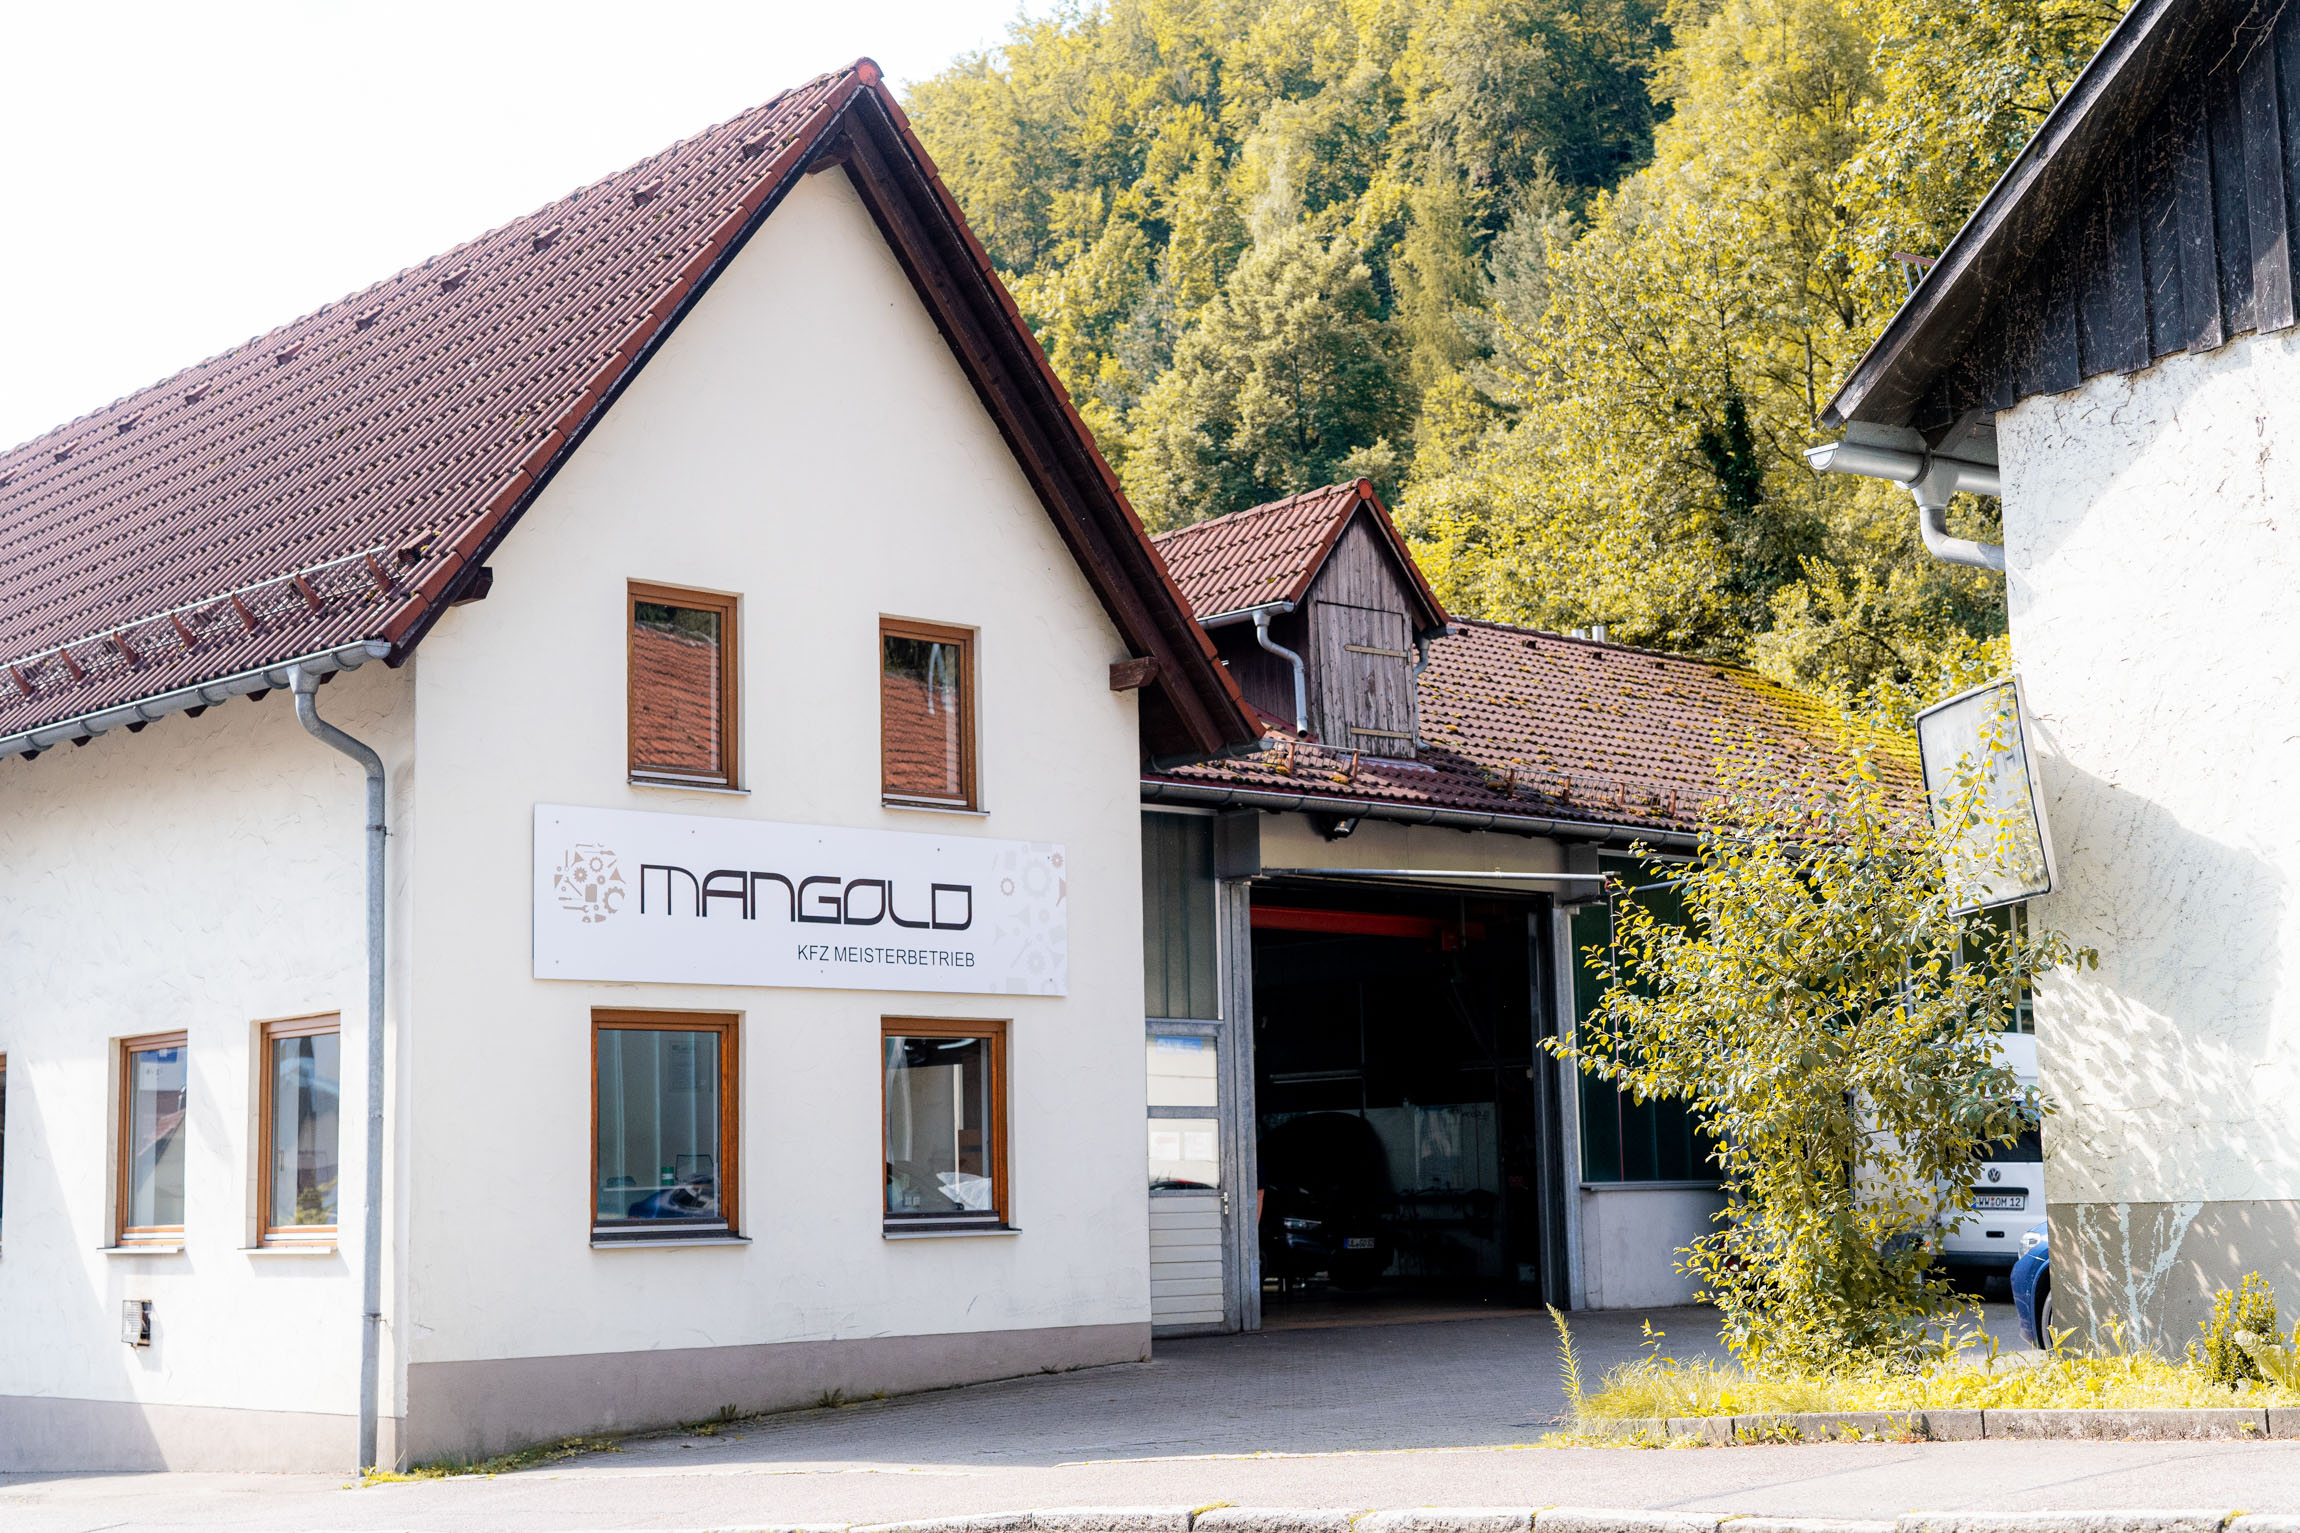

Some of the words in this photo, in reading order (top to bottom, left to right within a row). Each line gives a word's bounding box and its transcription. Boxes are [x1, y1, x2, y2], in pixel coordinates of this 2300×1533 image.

[641, 864, 972, 931] MANGOLD
[797, 944, 830, 962] KFZ
[834, 946, 976, 968] MEISTERBETRIEB
[2010, 1197, 2021, 1206] 12
